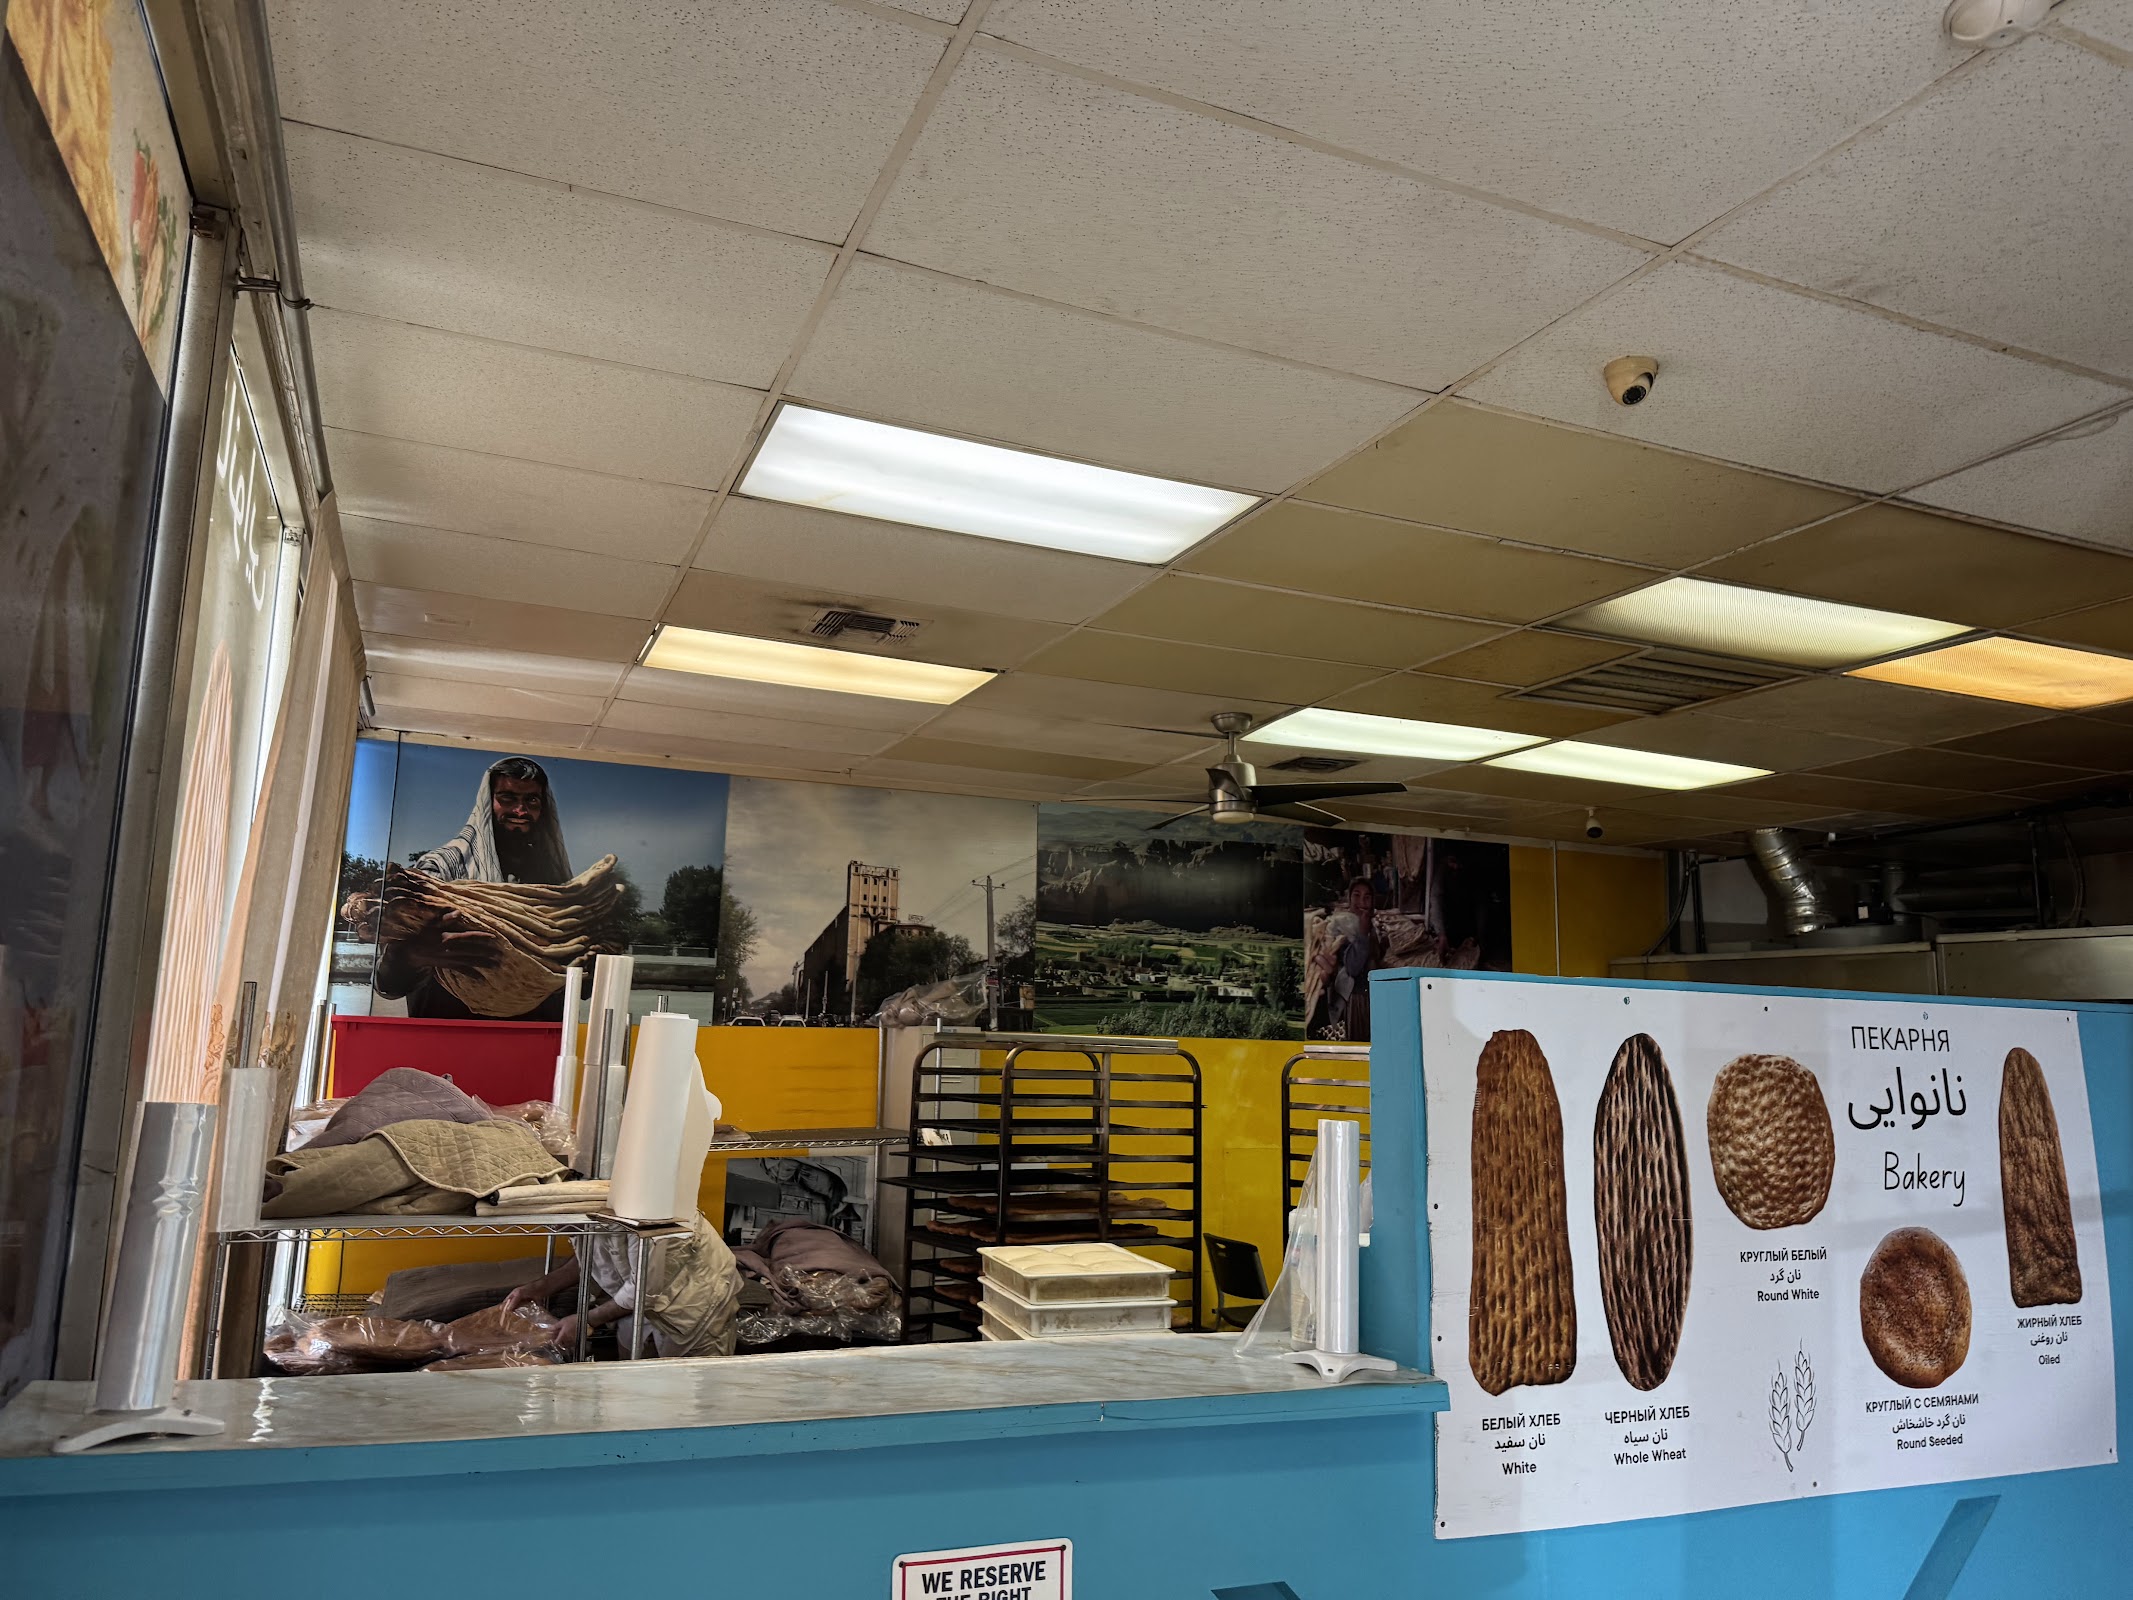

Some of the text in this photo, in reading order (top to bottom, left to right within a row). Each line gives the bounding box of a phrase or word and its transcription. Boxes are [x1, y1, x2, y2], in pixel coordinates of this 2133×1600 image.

[1851, 1026, 1950, 1052] ПЕКАРНЯ
[1848, 1066, 1967, 1130] نانوایی
[1884, 1151, 1965, 1207] Bakery
[1740, 1246, 1827, 1263] КРУГЛЫЙ БЕЛЫЙ
[1770, 1267, 1802, 1284] نان گرد
[1757, 1288, 1820, 1302] Round White
[2017, 1314, 2083, 1329] ЖИРНЫЙ ХЛЕБ
[2030, 1331, 2069, 1347] نان روغنی
[2038, 1354, 2061, 1365] Oiled
[1865, 1393, 1980, 1413] КРУГЛЫЙ С СЕМЯНАМИ
[1482, 1412, 1561, 1431] БЕЛЫЙ ХЛЕБ
[1605, 1405, 1690, 1424] ЧЕРНЫЙ ХЛЕБ
[1892, 1413, 1966, 1434] نان گرد خاشخاش
[1494, 1433, 1546, 1453] نان سفید
[1624, 1428, 1669, 1447] نان سیاه
[1897, 1433, 1964, 1450] Round Seeded
[1613, 1447, 1687, 1465] Whole Wheat
[1502, 1461, 1537, 1475] White
[921, 1560, 1047, 1594] WE RESERVE
